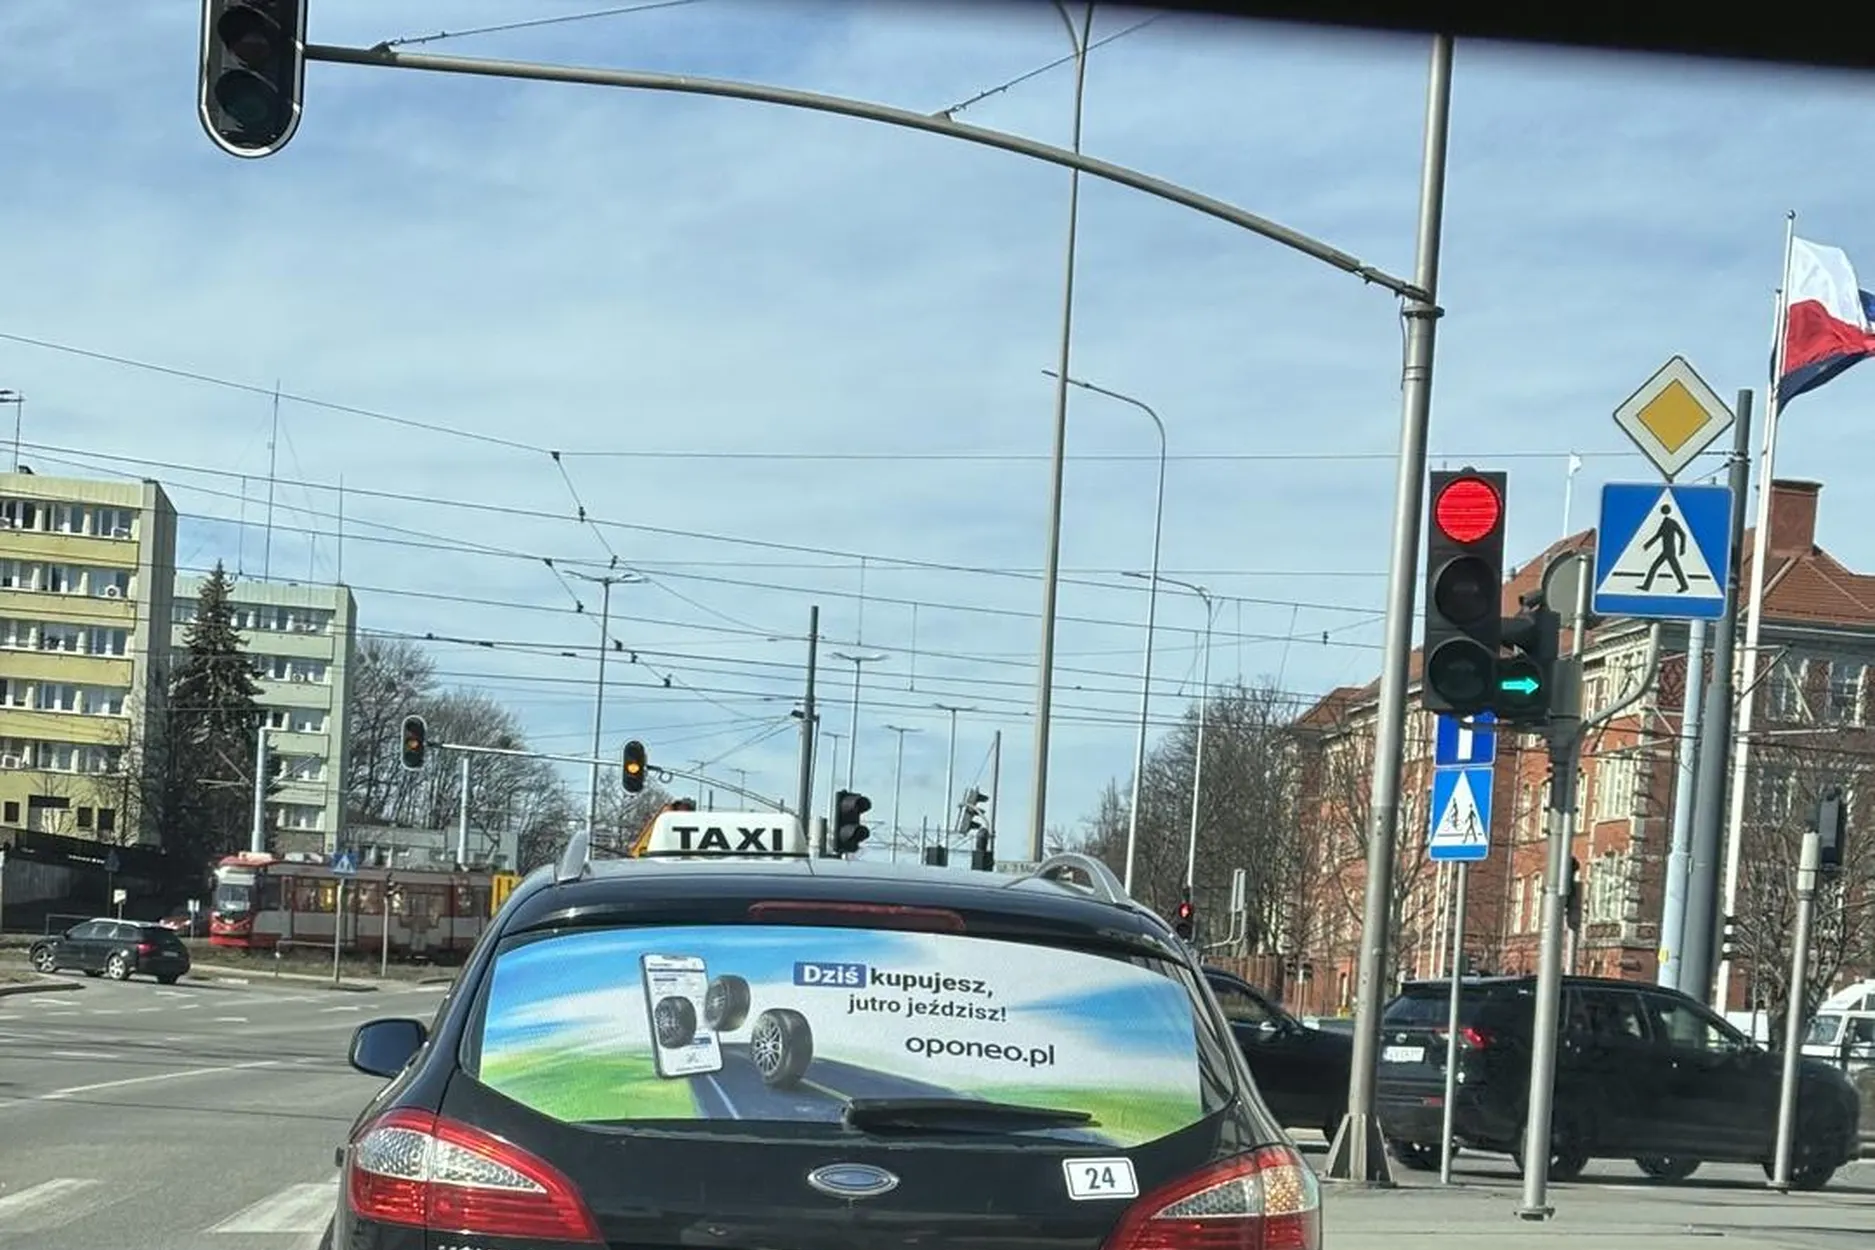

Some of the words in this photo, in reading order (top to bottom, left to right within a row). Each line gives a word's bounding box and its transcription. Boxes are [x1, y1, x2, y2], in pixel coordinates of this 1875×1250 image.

[672, 826, 783, 851] TAXI
[803, 964, 860, 985] Dziś
[870, 968, 994, 998] kupujesz,
[848, 995, 901, 1014] jutro
[906, 998, 1007, 1022] jeździsz!
[906, 1036, 1055, 1068] oponeo.pl
[1085, 1166, 1115, 1190] 24
